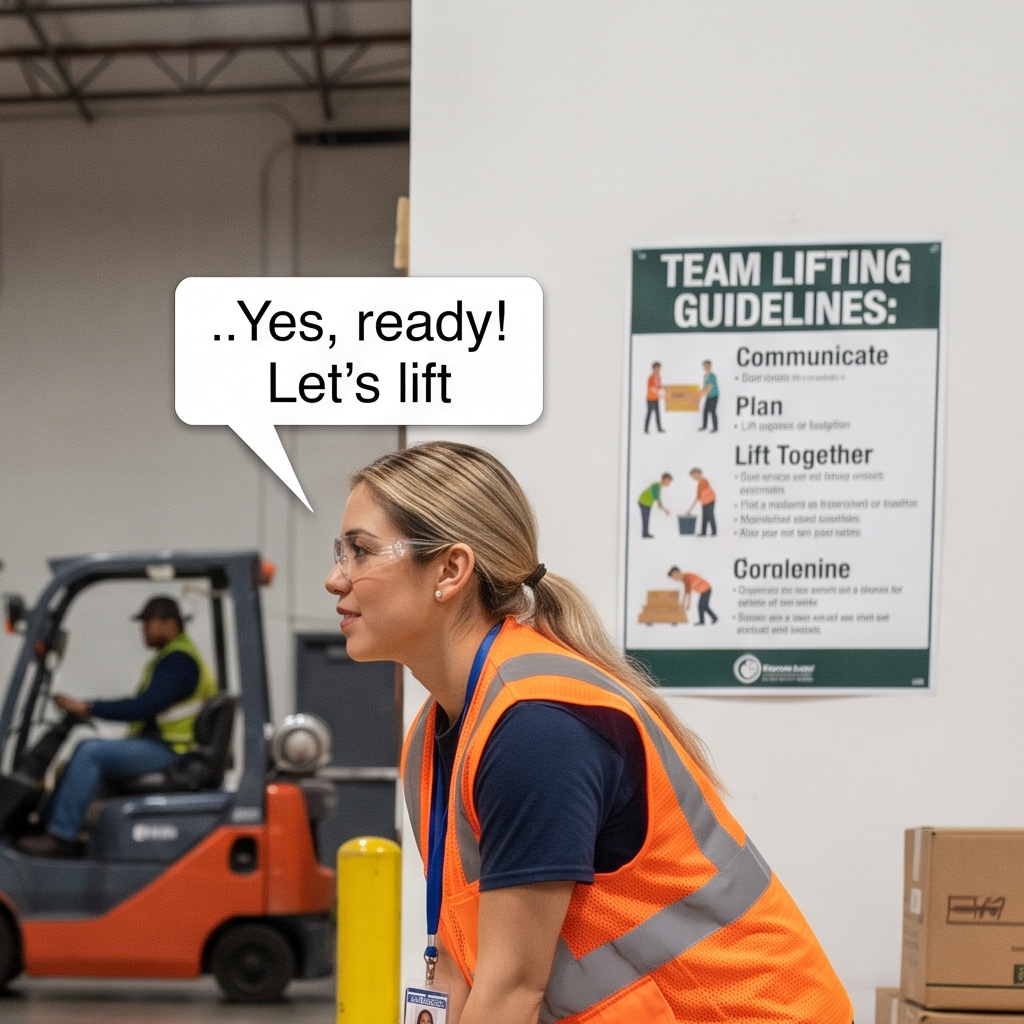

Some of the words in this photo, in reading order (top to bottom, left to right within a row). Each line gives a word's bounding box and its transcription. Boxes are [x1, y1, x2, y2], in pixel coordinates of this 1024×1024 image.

[660, 251, 762, 288] TEAM
[772, 248, 912, 286] LIFTING
[674, 289, 897, 328] GUIDELINES:
[736, 345, 889, 367] Communicate
[735, 396, 783, 416] Plan
[735, 445, 770, 466] Lift
[777, 444, 873, 470] Together
